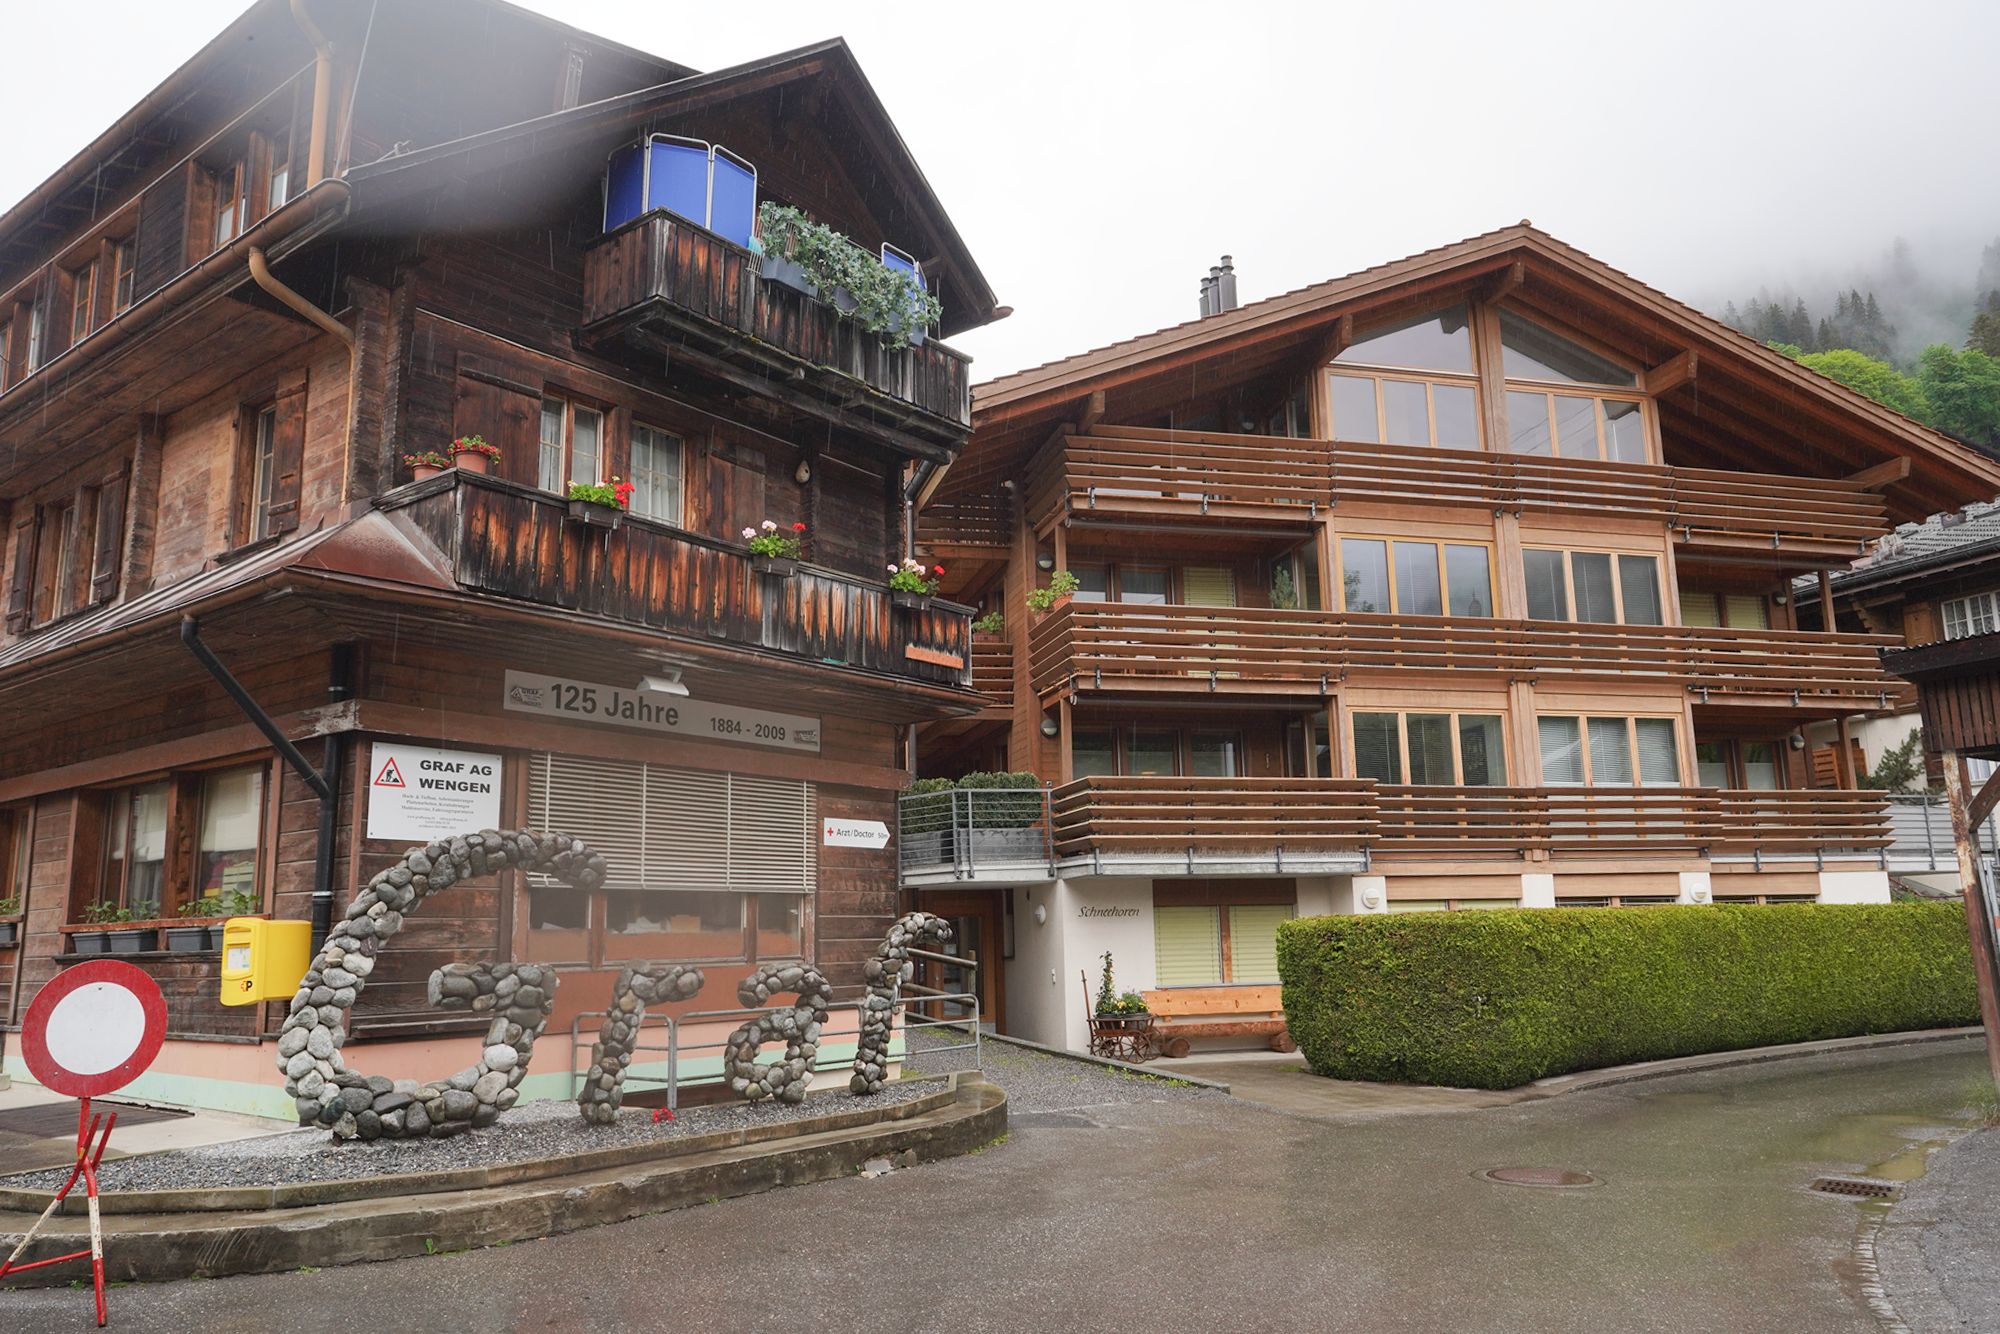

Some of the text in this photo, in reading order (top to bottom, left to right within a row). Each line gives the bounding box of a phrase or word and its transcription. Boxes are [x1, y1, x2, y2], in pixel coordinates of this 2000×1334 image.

[551, 683, 679, 726] 125 Jahre
[710, 717, 742, 735] 1884
[755, 723, 786, 741] 2009
[419, 759, 493, 776] GRAF AG
[419, 778, 491, 794] WENGEN
[1078, 905, 1140, 918] Schneehoren
